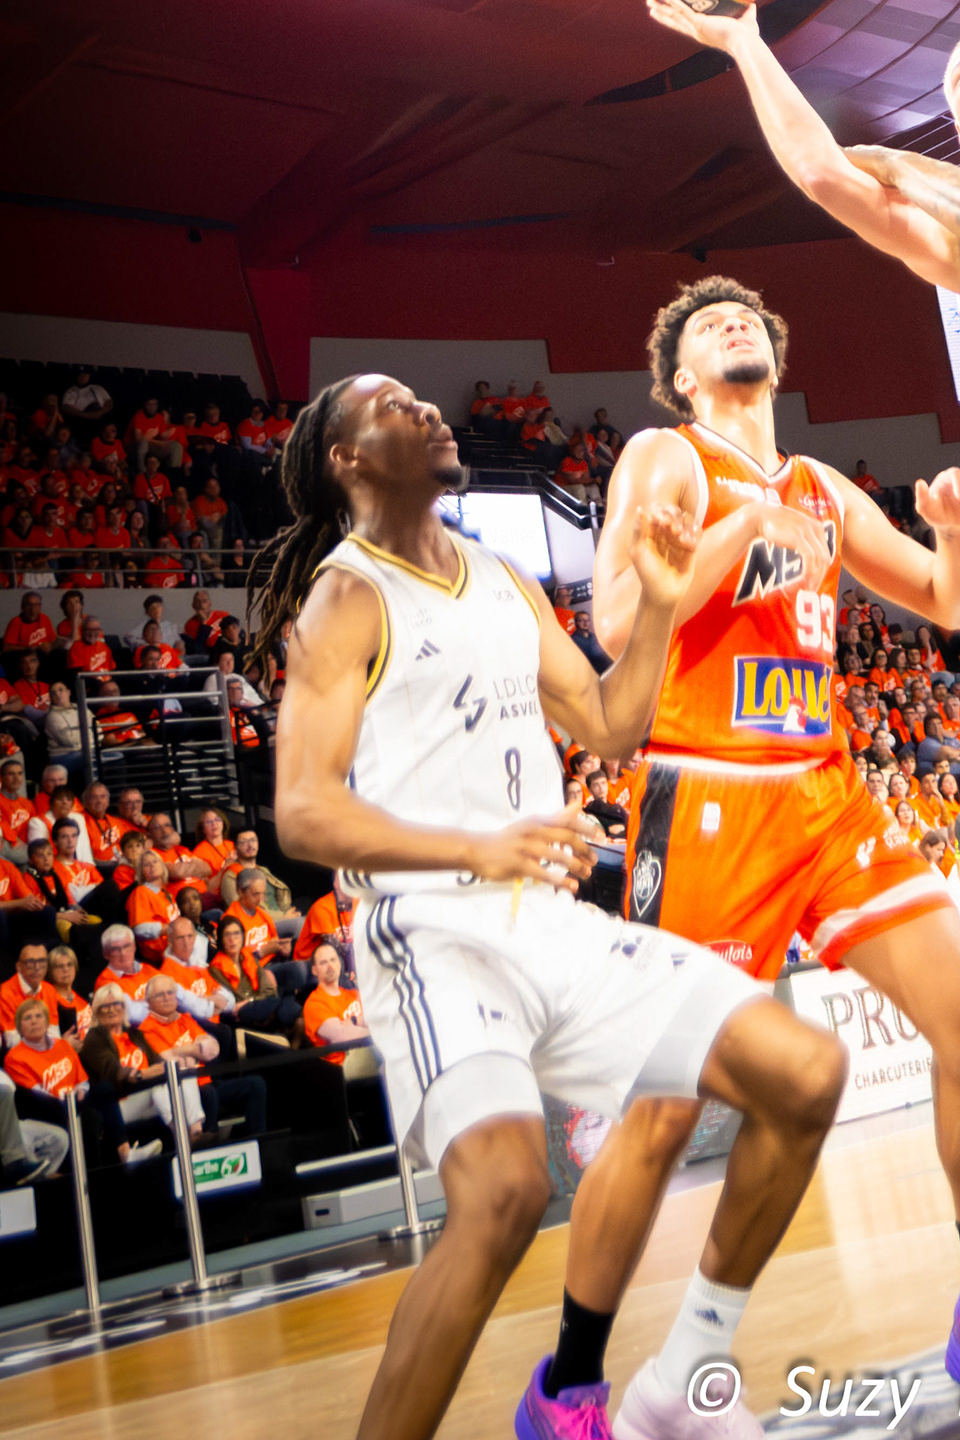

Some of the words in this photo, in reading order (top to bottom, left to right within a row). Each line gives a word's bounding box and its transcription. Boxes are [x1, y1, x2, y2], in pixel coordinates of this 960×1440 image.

[732, 521, 836, 608] MS
[796, 589, 835, 653] 93
[493, 674, 537, 700] LDLC
[500, 701, 539, 720] ASVEL
[504, 747, 521, 811] 8
